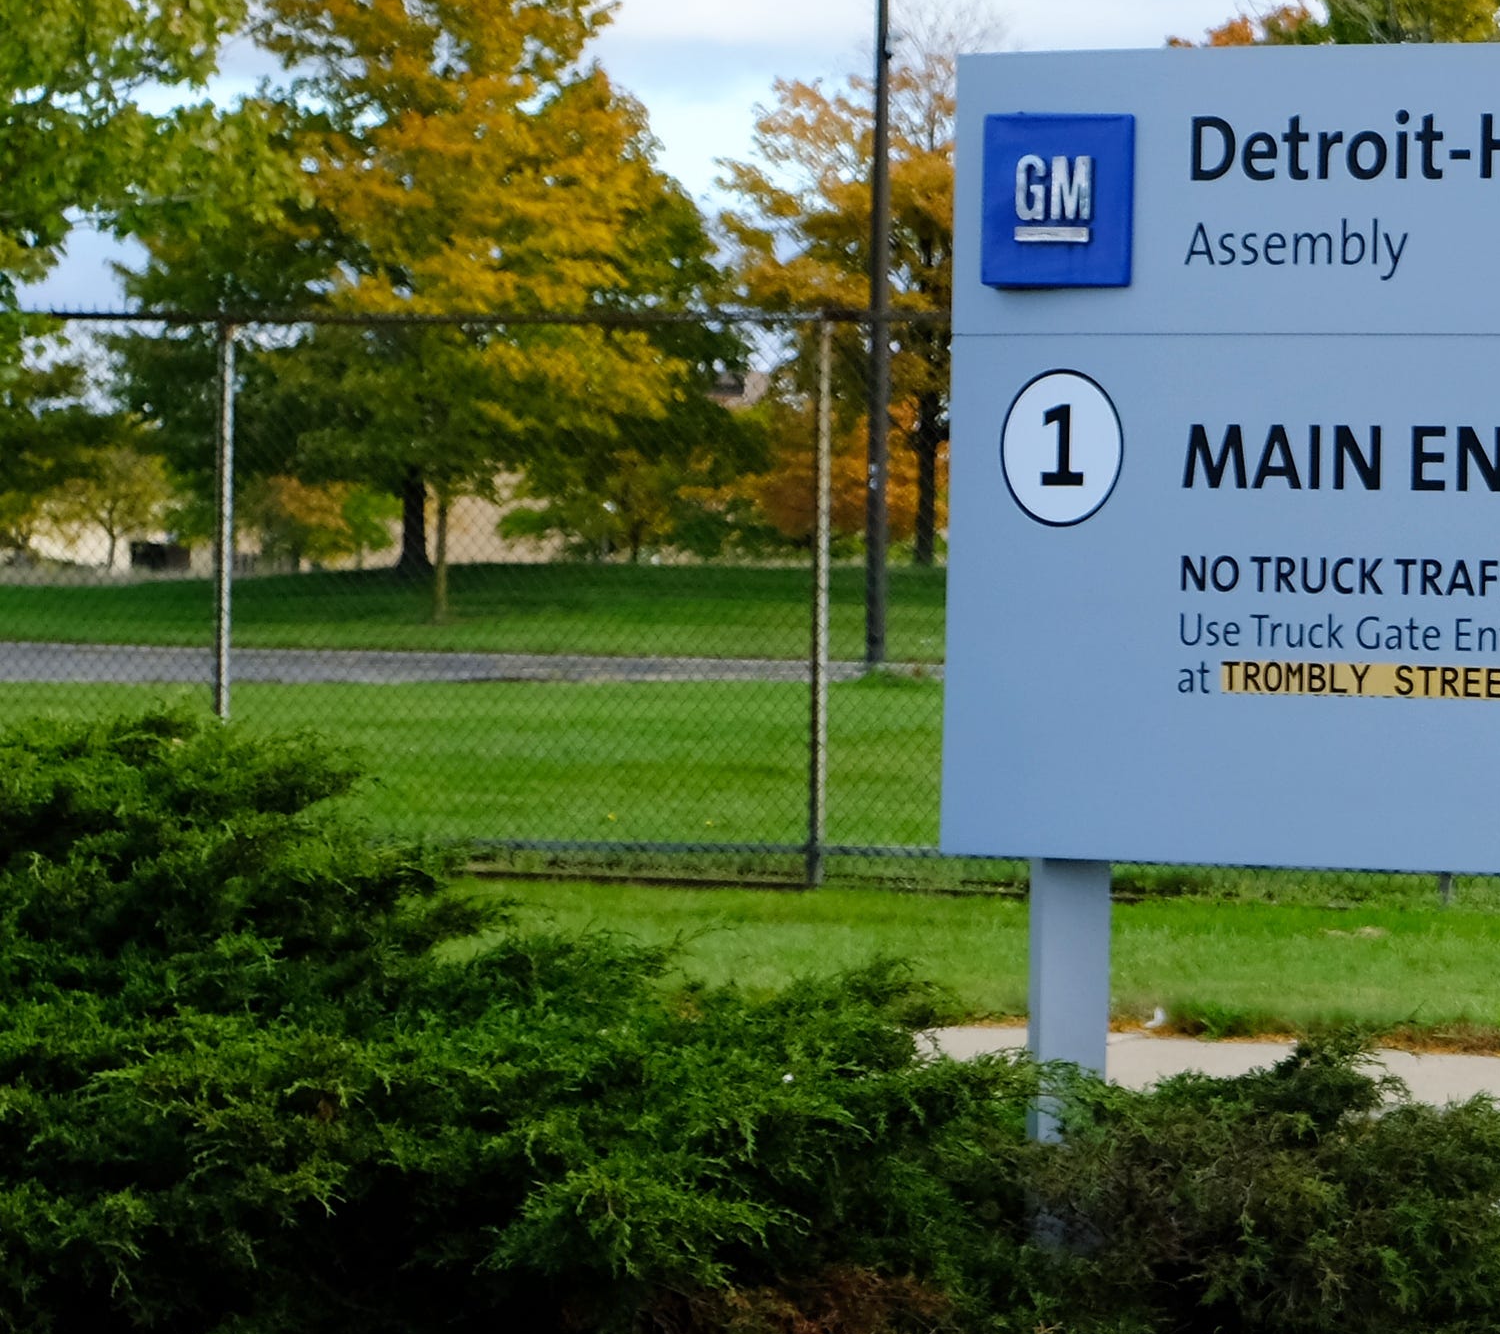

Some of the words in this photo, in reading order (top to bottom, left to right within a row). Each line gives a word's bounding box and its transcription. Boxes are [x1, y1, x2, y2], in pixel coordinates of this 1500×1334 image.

[1014, 154, 1092, 222] GM
[1184, 218, 1409, 280] Assembly
[1040, 403, 1084, 487] 1
[1181, 423, 1382, 490] MAIN
[1179, 554, 1240, 593] NO
[1250, 555, 1384, 596] TRUCK
[1178, 612, 1241, 647] Use
[1250, 613, 1344, 650] Truck
[1355, 615, 1442, 654] Gate
[1177, 661, 1211, 695] at
[1222, 661, 1371, 695] TROMBLY
